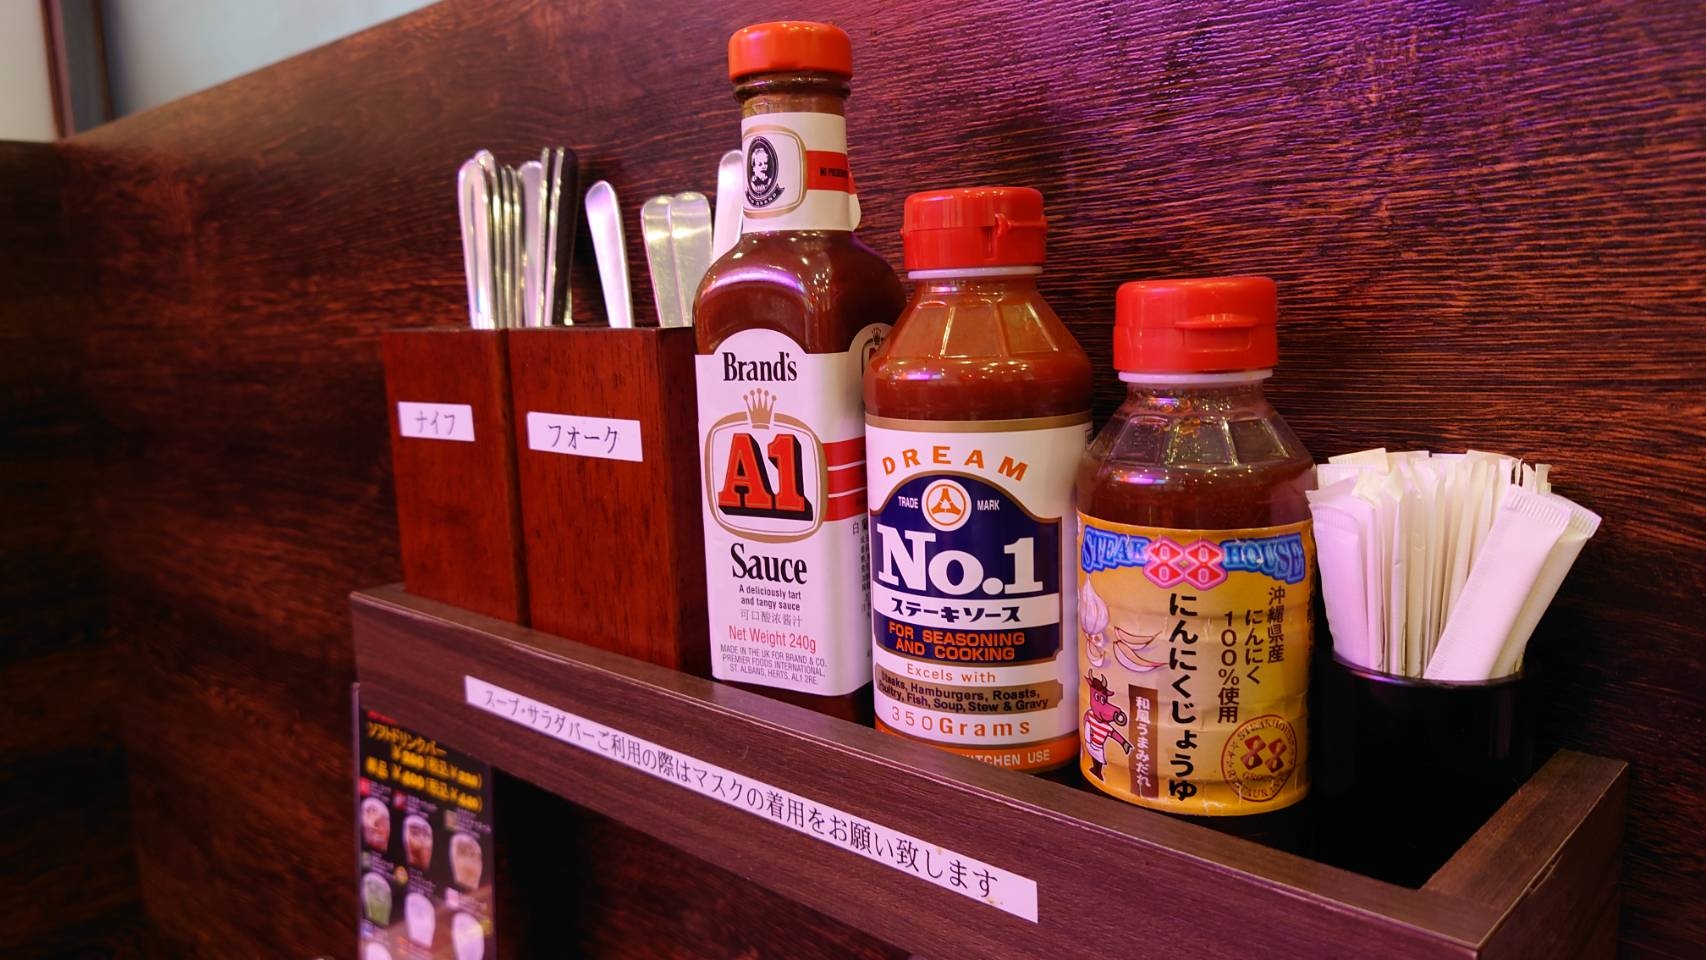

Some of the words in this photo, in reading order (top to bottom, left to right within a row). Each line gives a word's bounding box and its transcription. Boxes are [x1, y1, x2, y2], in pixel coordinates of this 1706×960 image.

[722, 351, 798, 382] Brand's
[416, 410, 456, 436] ナイフ
[548, 424, 618, 454] フォーク
[718, 432, 813, 521] A1
[882, 446, 1028, 482] DREAM
[898, 496, 919, 509] TRADE
[977, 500, 1000, 511] MARK
[730, 542, 808, 584] Sauce
[876, 523, 1044, 596] No.1
[1083, 528, 1147, 572] STEAK
[1221, 533, 1305, 583] HOUSE
[739, 584, 744, 593] A
[746, 586, 786, 599] deliciously
[788, 590, 801, 600] tart
[741, 596, 754, 605] and
[757, 598, 776, 610] tangy
[778, 601, 800, 611] sauce
[891, 597, 1022, 623] ステーキソース
[888, 621, 914, 640] FOR
[922, 630, 1025, 648] SEASONING
[1267, 586, 1286, 664] 沖縄県産
[729, 625, 746, 641] Net
[749, 628, 786, 648] Weight
[789, 633, 816, 654] 240g
[895, 637, 925, 656] AND
[934, 646, 1015, 661] COOKING
[1245, 609, 1264, 685] にんにく
[720, 644, 738, 654] MADE
[740, 647, 747, 655] IN
[748, 648, 760, 657] THE
[762, 650, 770, 658] UK
[772, 651, 784, 660] FOR
[786, 653, 807, 664] BRAND
[722, 654, 750, 665] PREMIER
[752, 658, 772, 668] FOODS
[741, 666, 766, 677] ALBANS,
[791, 674, 802, 682] AL1
[906, 663, 953, 681] Excels
[961, 672, 996, 683] with
[1218, 612, 1240, 724] 100%使用
[907, 692, 931, 709] Fish,
[934, 698, 965, 713] Soup,
[968, 701, 999, 713] Stew
[1003, 702, 1012, 711] &
[1015, 698, 1048, 711] Gravy
[910, 682, 988, 703] Hamburgers,
[992, 688, 1040, 700] Roasts,
[1168, 593, 1198, 802] にんにくじょうゆ
[1135, 696, 1152, 788] 和風うまみだれ
[962, 754, 1021, 766] TCHEN
[1028, 749, 1050, 764] USE
